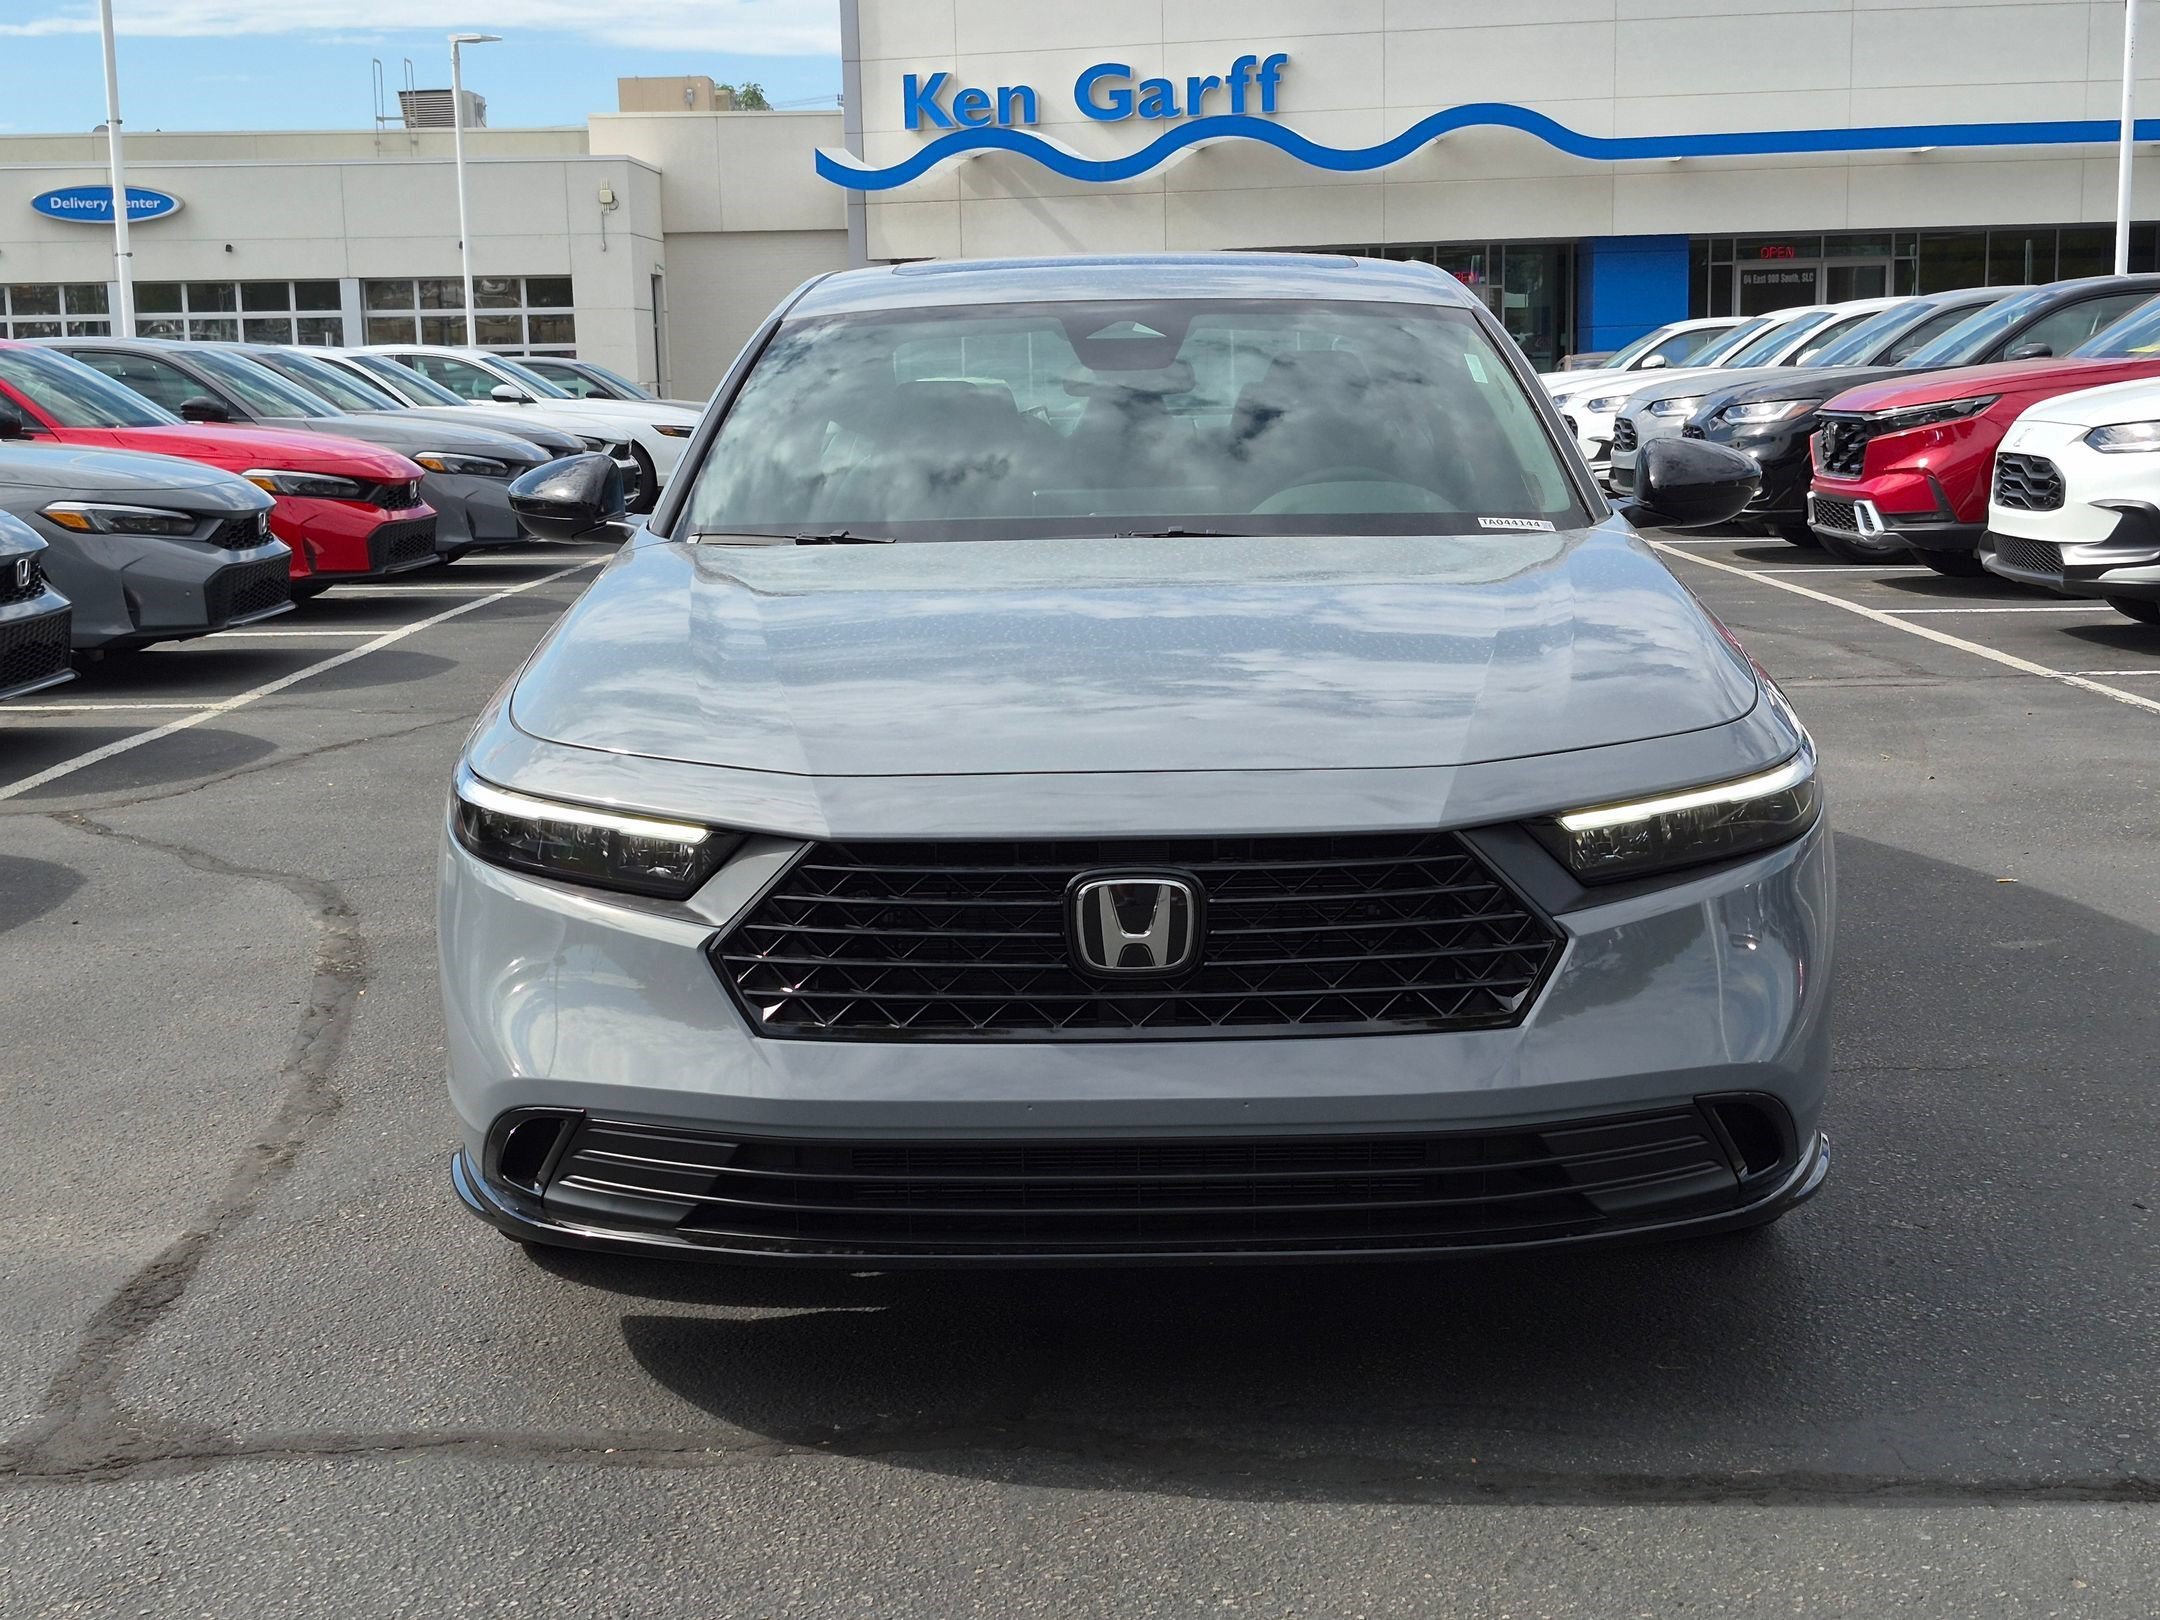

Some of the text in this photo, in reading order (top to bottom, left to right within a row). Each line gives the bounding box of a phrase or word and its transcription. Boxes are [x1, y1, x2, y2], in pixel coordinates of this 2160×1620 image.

[902, 53, 1289, 131] Ken Garff
[50, 197, 108, 212] Delivery
[1760, 246, 1795, 259] OPEN
[1753, 274, 1766, 284] East
[1802, 272, 1814, 282] SLC
